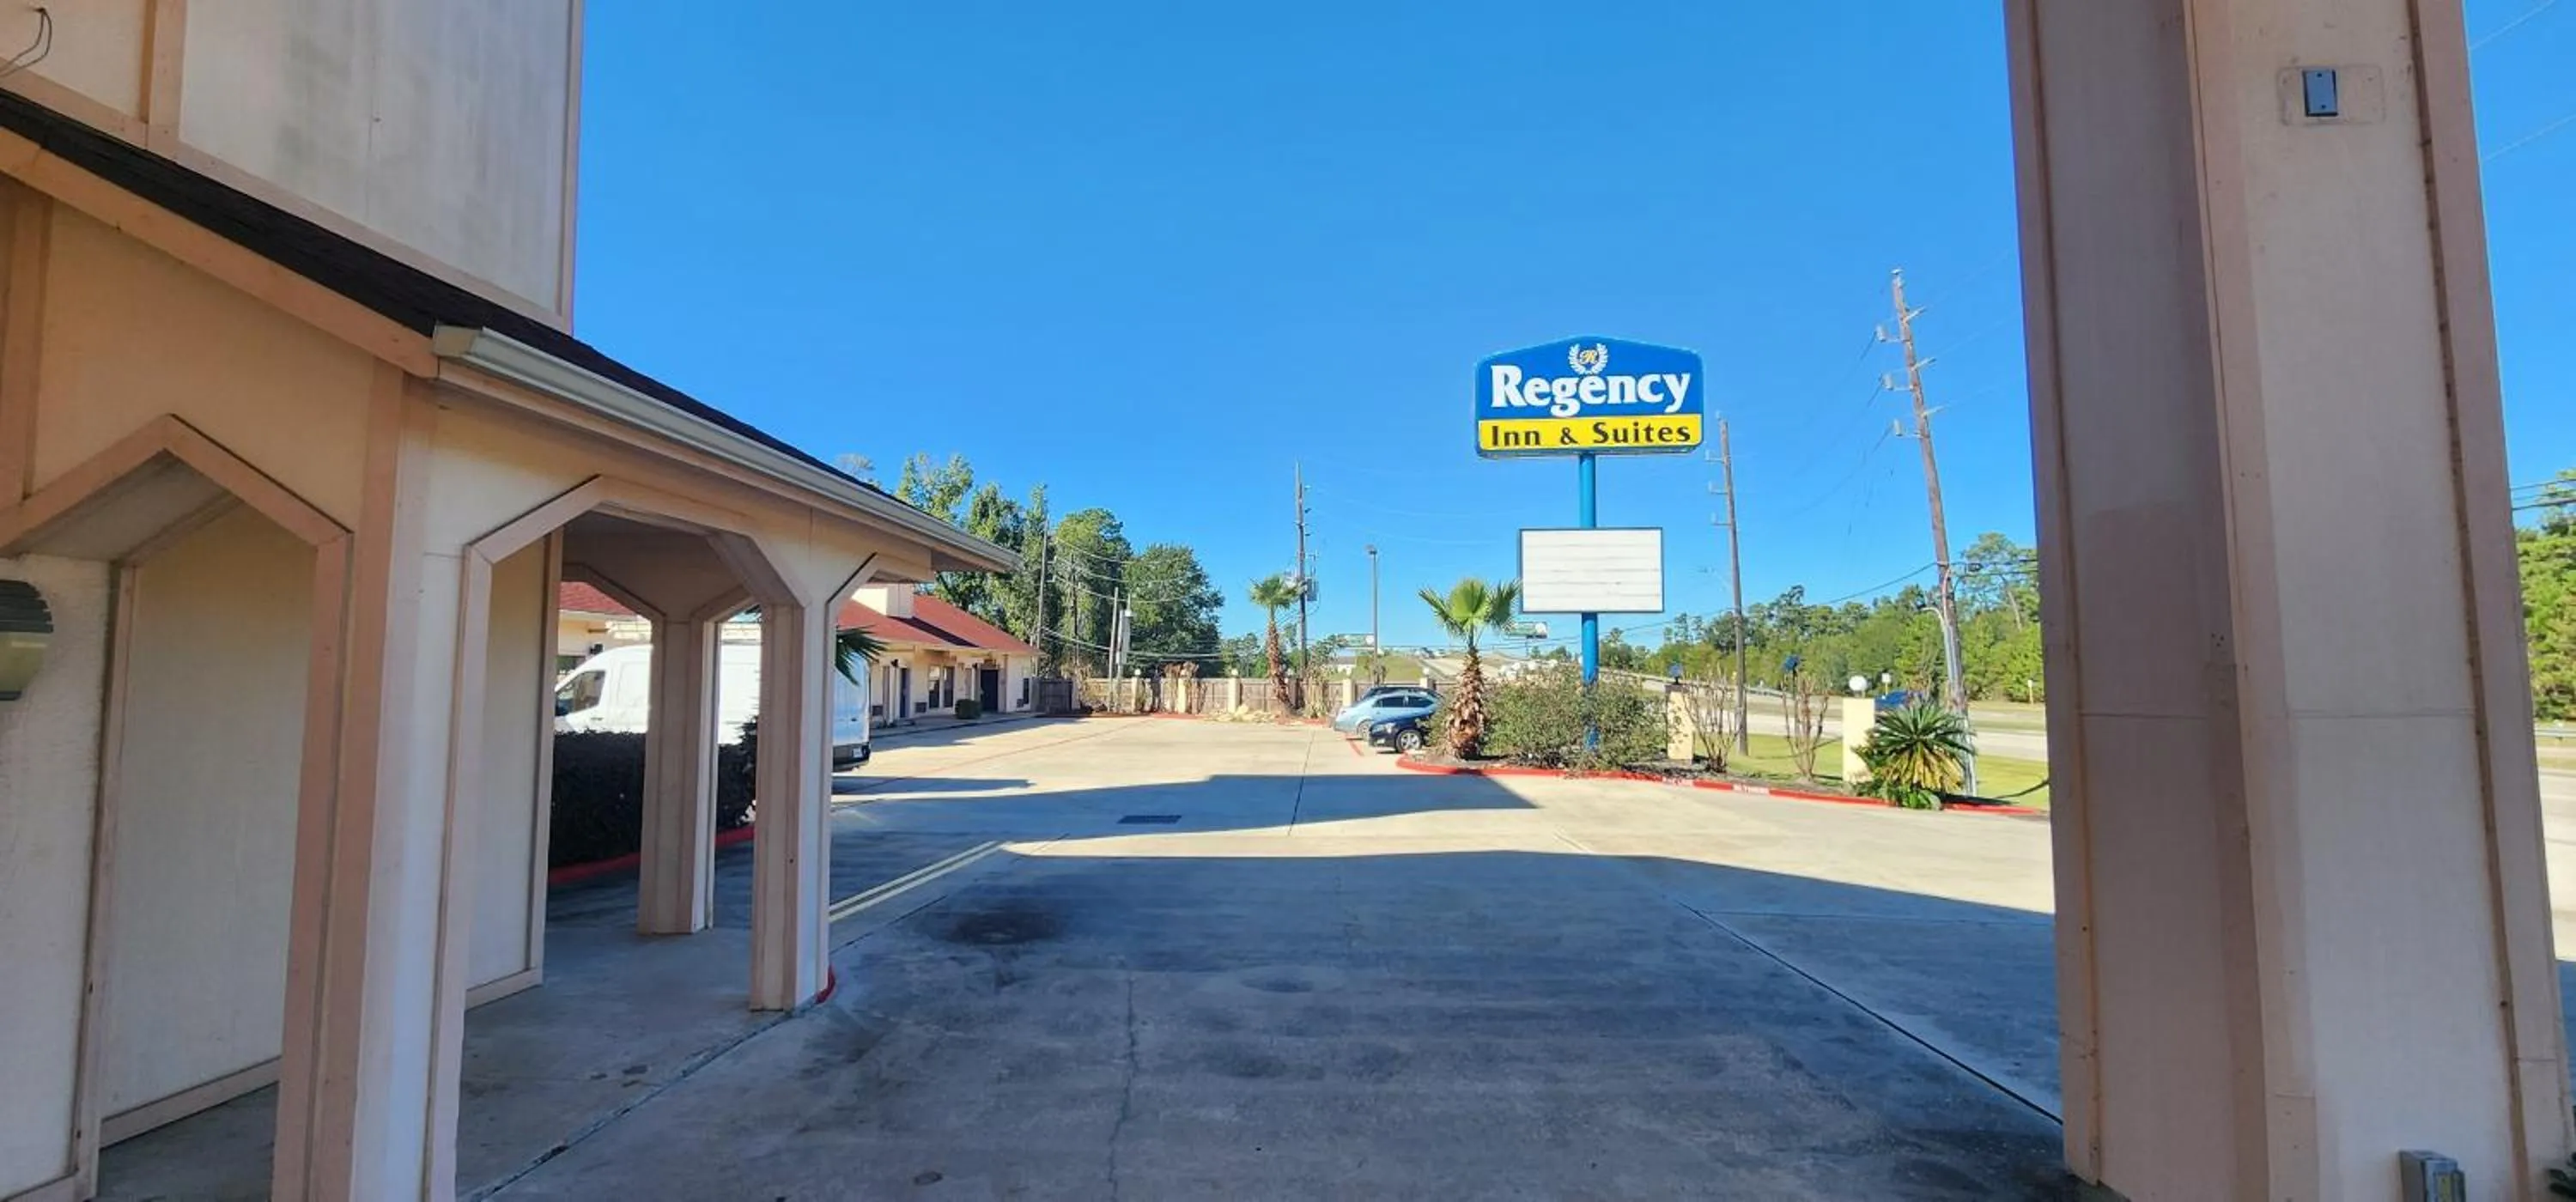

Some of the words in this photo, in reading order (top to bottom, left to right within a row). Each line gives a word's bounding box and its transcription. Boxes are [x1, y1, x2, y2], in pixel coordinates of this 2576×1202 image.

[1491, 365, 1691, 417] Regency
[1492, 426, 1540, 446] Inn
[1560, 428, 1578, 445] &
[1594, 422, 1691, 444] Suites
